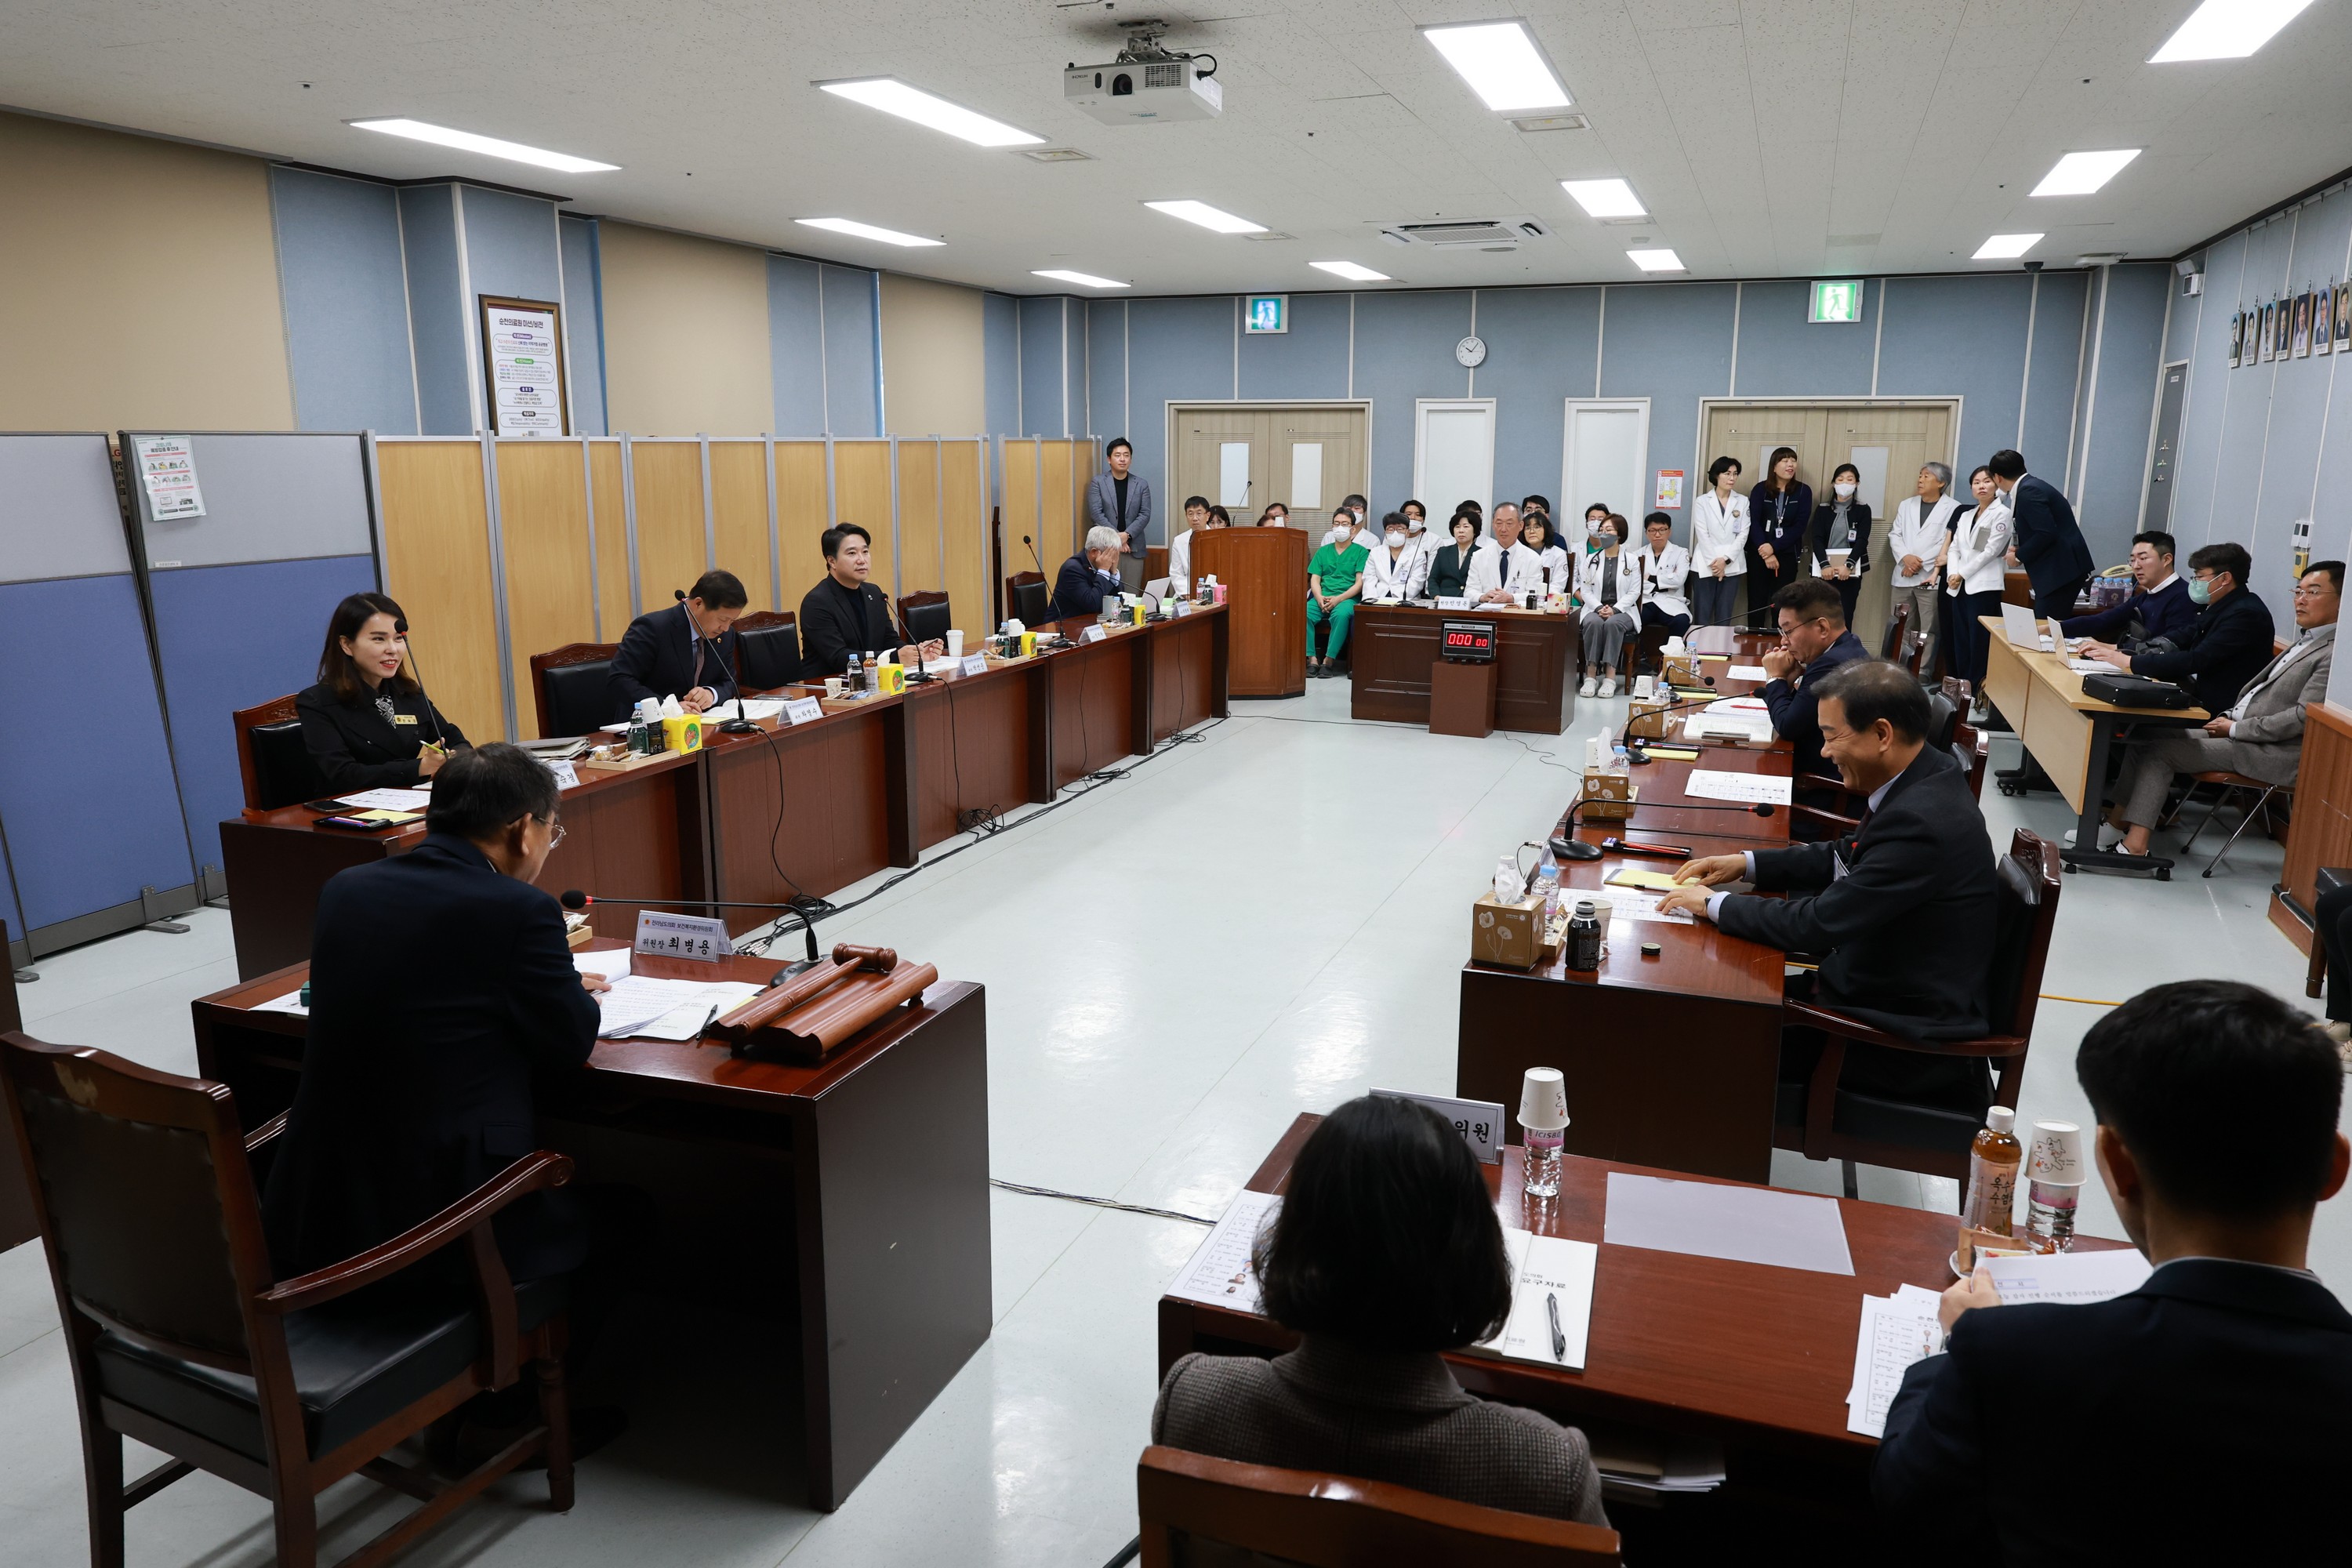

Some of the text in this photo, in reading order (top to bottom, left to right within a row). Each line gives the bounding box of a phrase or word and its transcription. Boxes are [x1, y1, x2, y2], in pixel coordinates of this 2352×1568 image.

[499, 318, 523, 327] 순천의료원
[1448, 633, 1487, 647] 000 00
[677, 924, 713, 932] 보건복지환경위원회
[642, 936, 710, 955] 위원장 최병용
[1520, 1278, 1567, 1288] 요구자료
